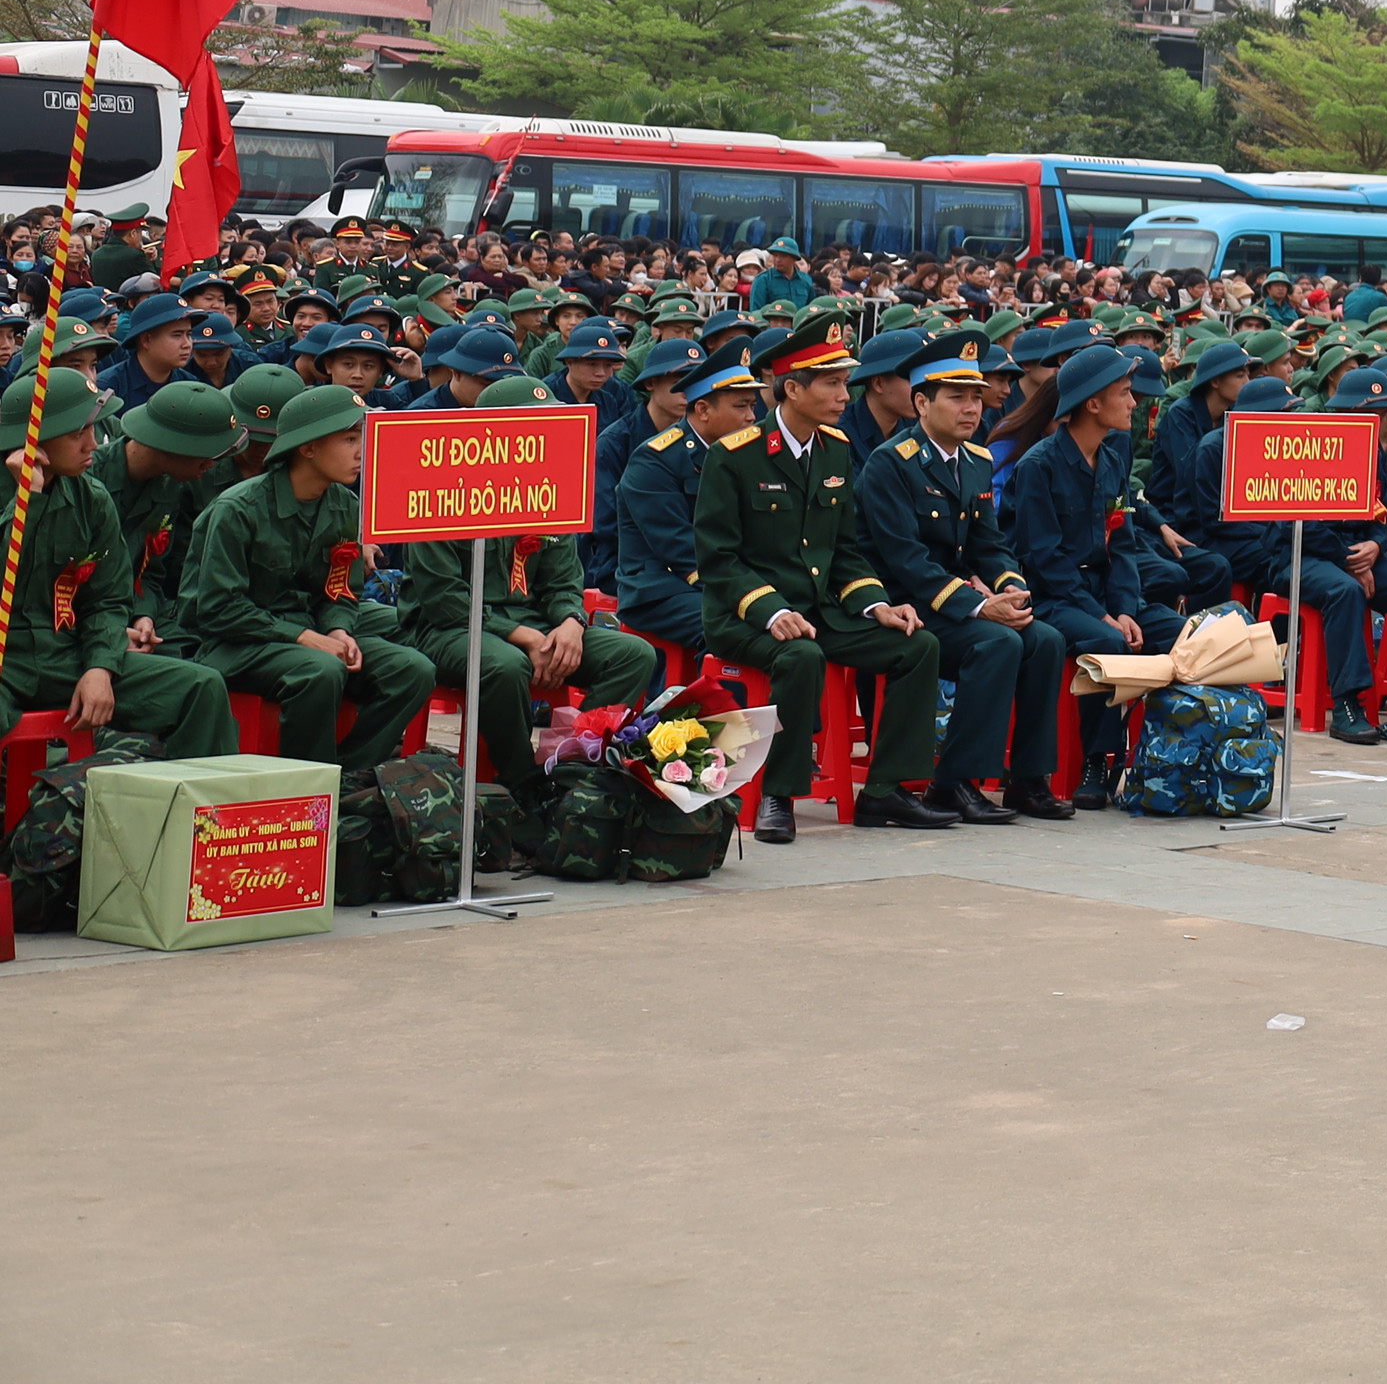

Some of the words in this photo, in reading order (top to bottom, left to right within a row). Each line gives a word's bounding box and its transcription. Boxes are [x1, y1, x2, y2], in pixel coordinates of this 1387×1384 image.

[420, 436, 445, 467] SƯ
[449, 428, 509, 466] ĐOÀN
[514, 435, 545, 464] 301
[1264, 435, 1280, 460] SƯ
[1282, 429, 1320, 460] ĐOÀN
[1323, 437, 1343, 460] 371
[408, 490, 432, 519] BTL
[437, 477, 465, 517] THỦ
[470, 480, 495, 515] ĐÔ
[500, 476, 522, 513] HÀ
[527, 478, 557, 518] NỘI
[1245, 472, 1279, 502] QUÂN
[1281, 469, 1322, 501] CHỦNG
[1324, 478, 1357, 501] PK-KQ
[290, 820, 313, 832] UBND
[206, 843, 218, 858] ỦY
[220, 844, 239, 857] BAN
[241, 842, 264, 855] MTTQ
[280, 838, 297, 850] NGA
[300, 835, 318, 848] SƠN
[230, 868, 287, 891] Tặng
